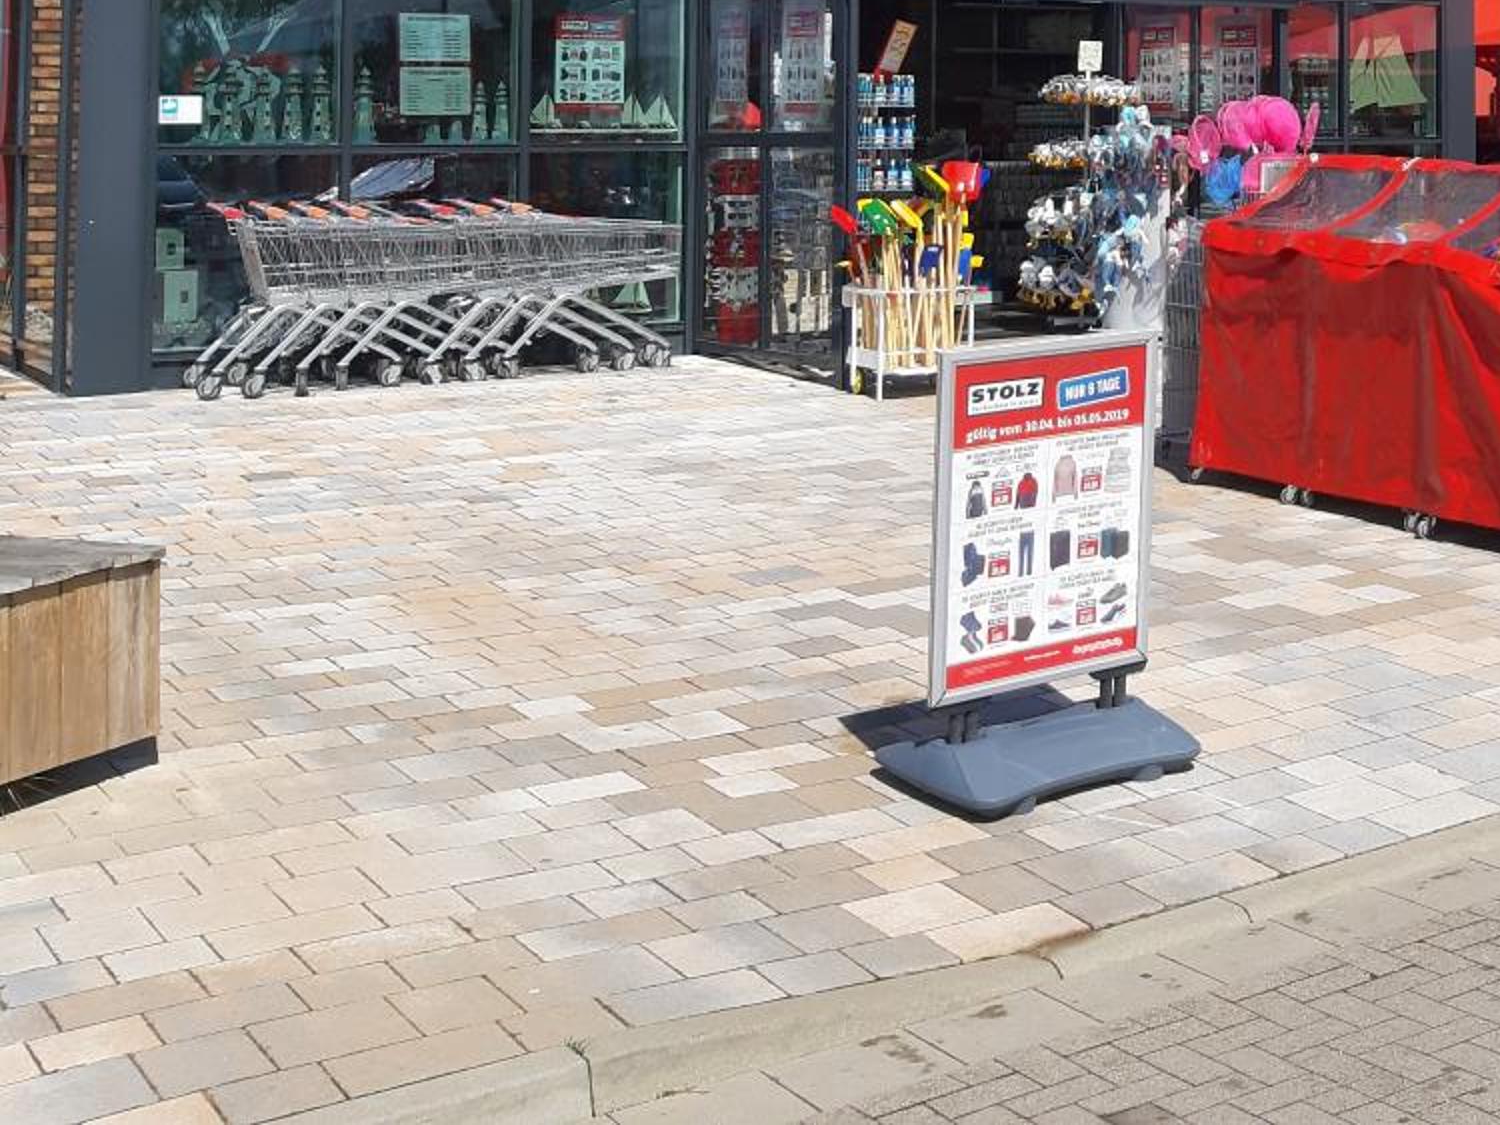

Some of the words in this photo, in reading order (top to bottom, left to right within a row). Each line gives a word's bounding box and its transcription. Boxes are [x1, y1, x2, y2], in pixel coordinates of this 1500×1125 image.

[972, 382, 1040, 404] STOLZ
[1065, 384, 1086, 402] NUR
[1096, 376, 1121, 394] TAGE
[966, 426, 997, 444] gültig
[999, 423, 1023, 436] vom
[1056, 416, 1073, 428] bis
